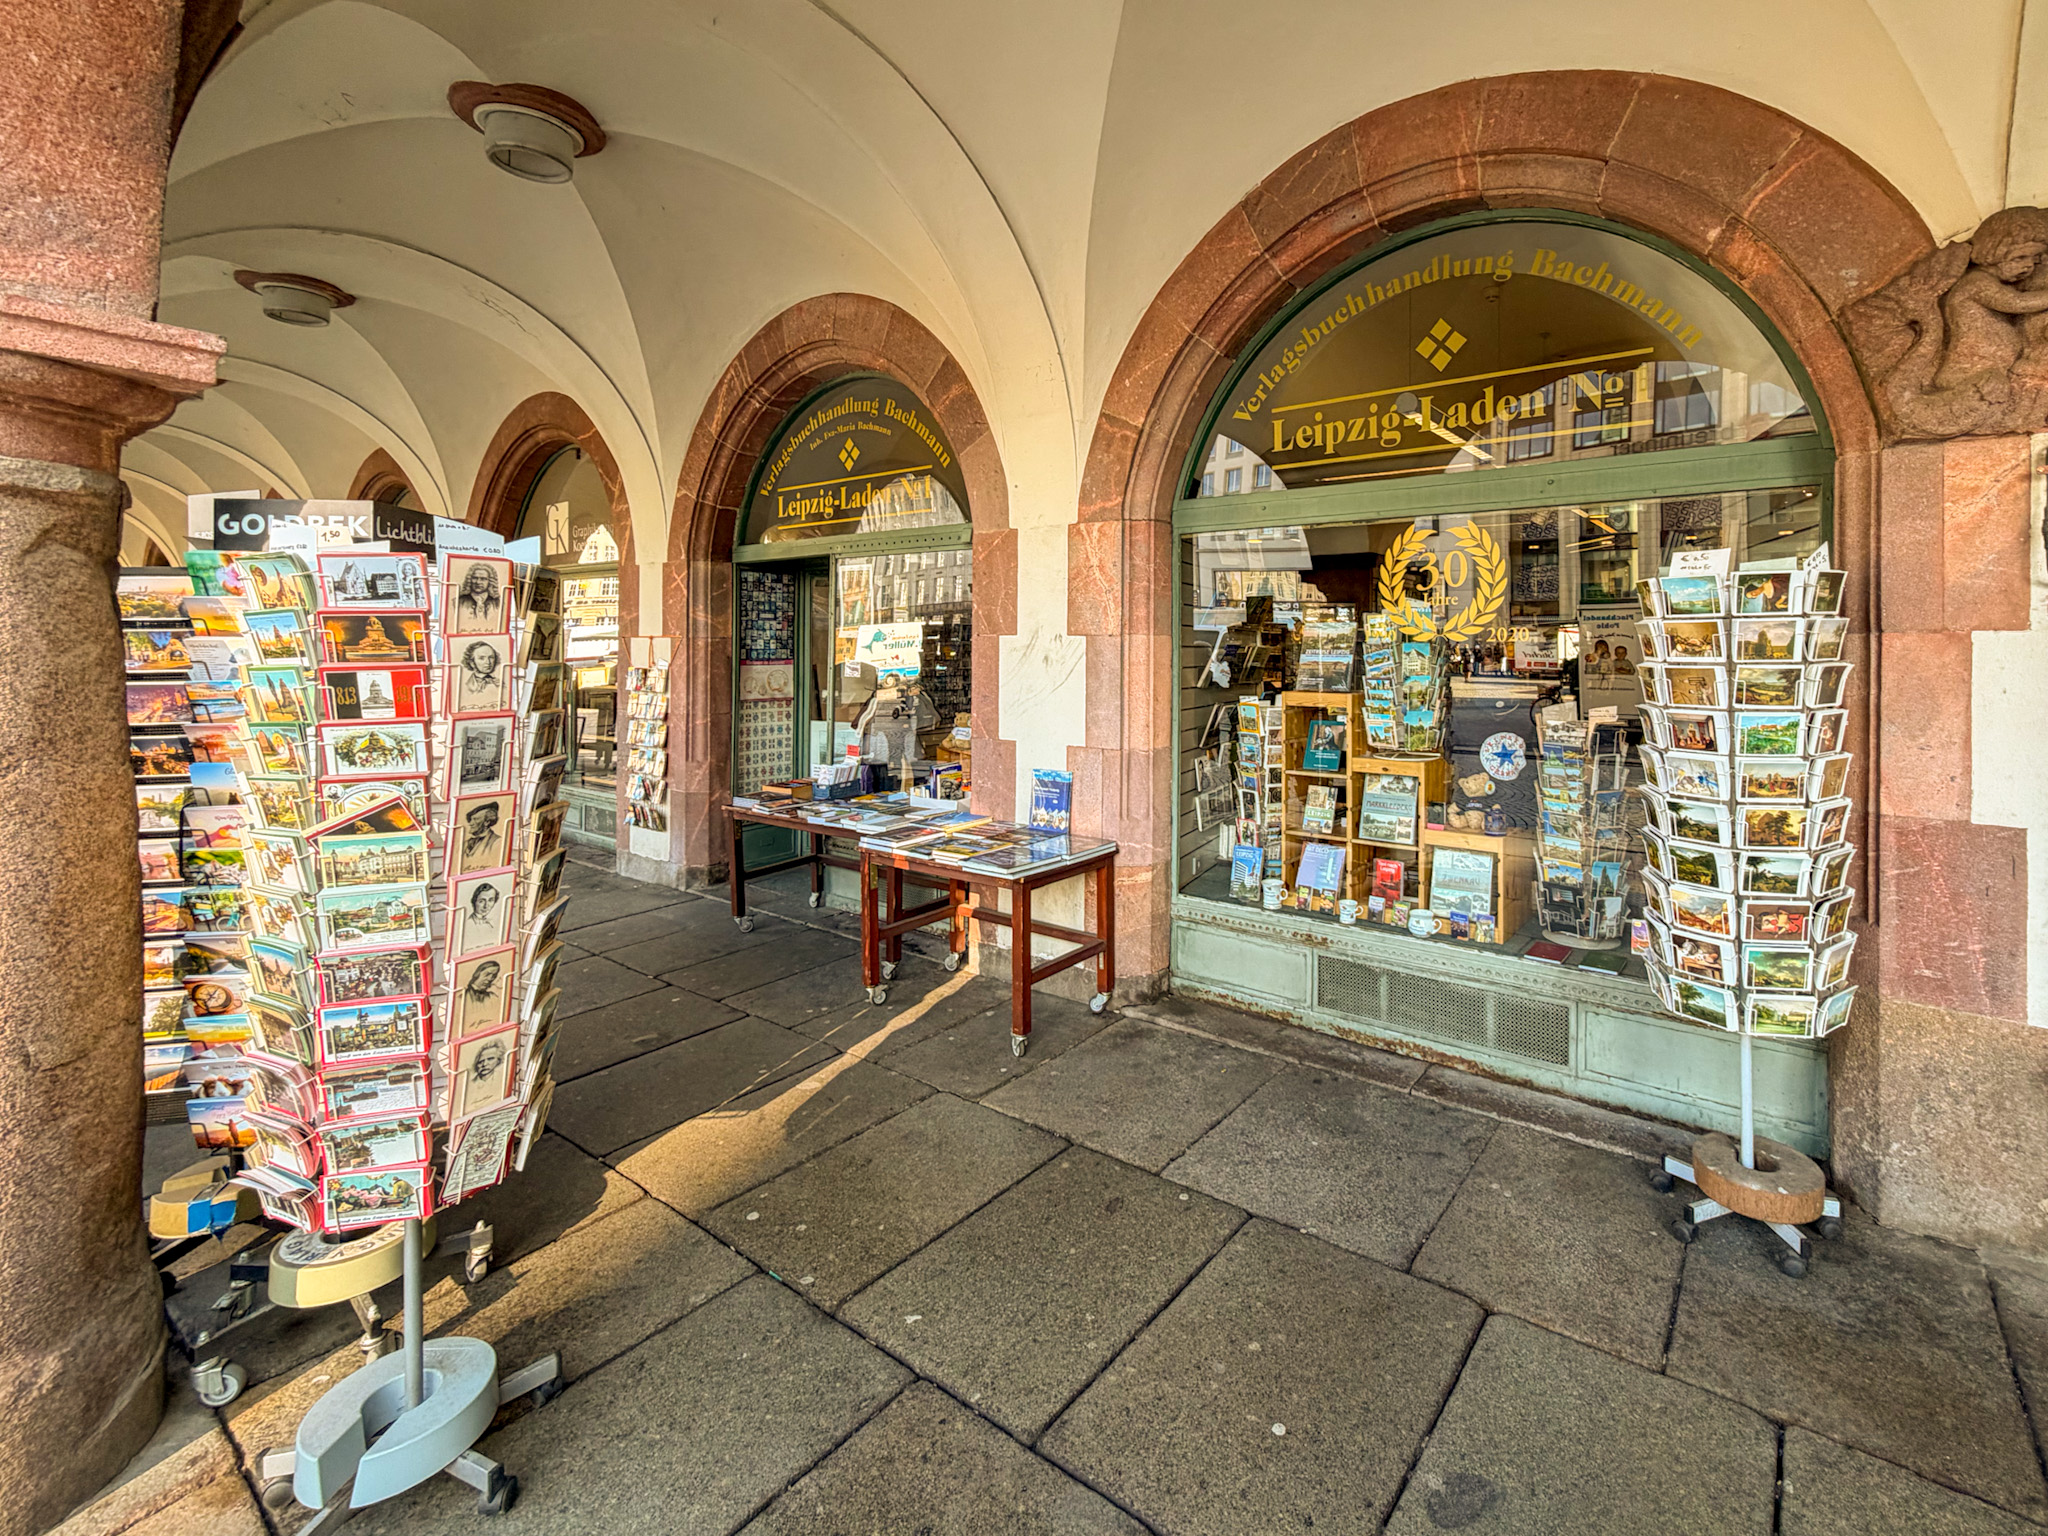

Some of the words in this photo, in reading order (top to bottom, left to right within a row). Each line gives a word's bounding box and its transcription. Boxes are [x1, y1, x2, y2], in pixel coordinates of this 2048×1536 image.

[1232, 249, 1515, 424] Verlagsbuchhandlung
[1528, 248, 1704, 350] Bachmann
[1271, 386, 1546, 454] Leipzig-Laden
[760, 396, 880, 497] Verlagsbuchhandlung
[884, 398, 951, 468] Bachmann
[778, 482, 892, 520] Leipzig-Laden
[376, 516, 435, 545] Lichtbli
[1415, 550, 1468, 592] 30
[1422, 592, 1459, 607] Jahre
[1486, 627, 1530, 643] 2020
[336, 686, 357, 705] 813
